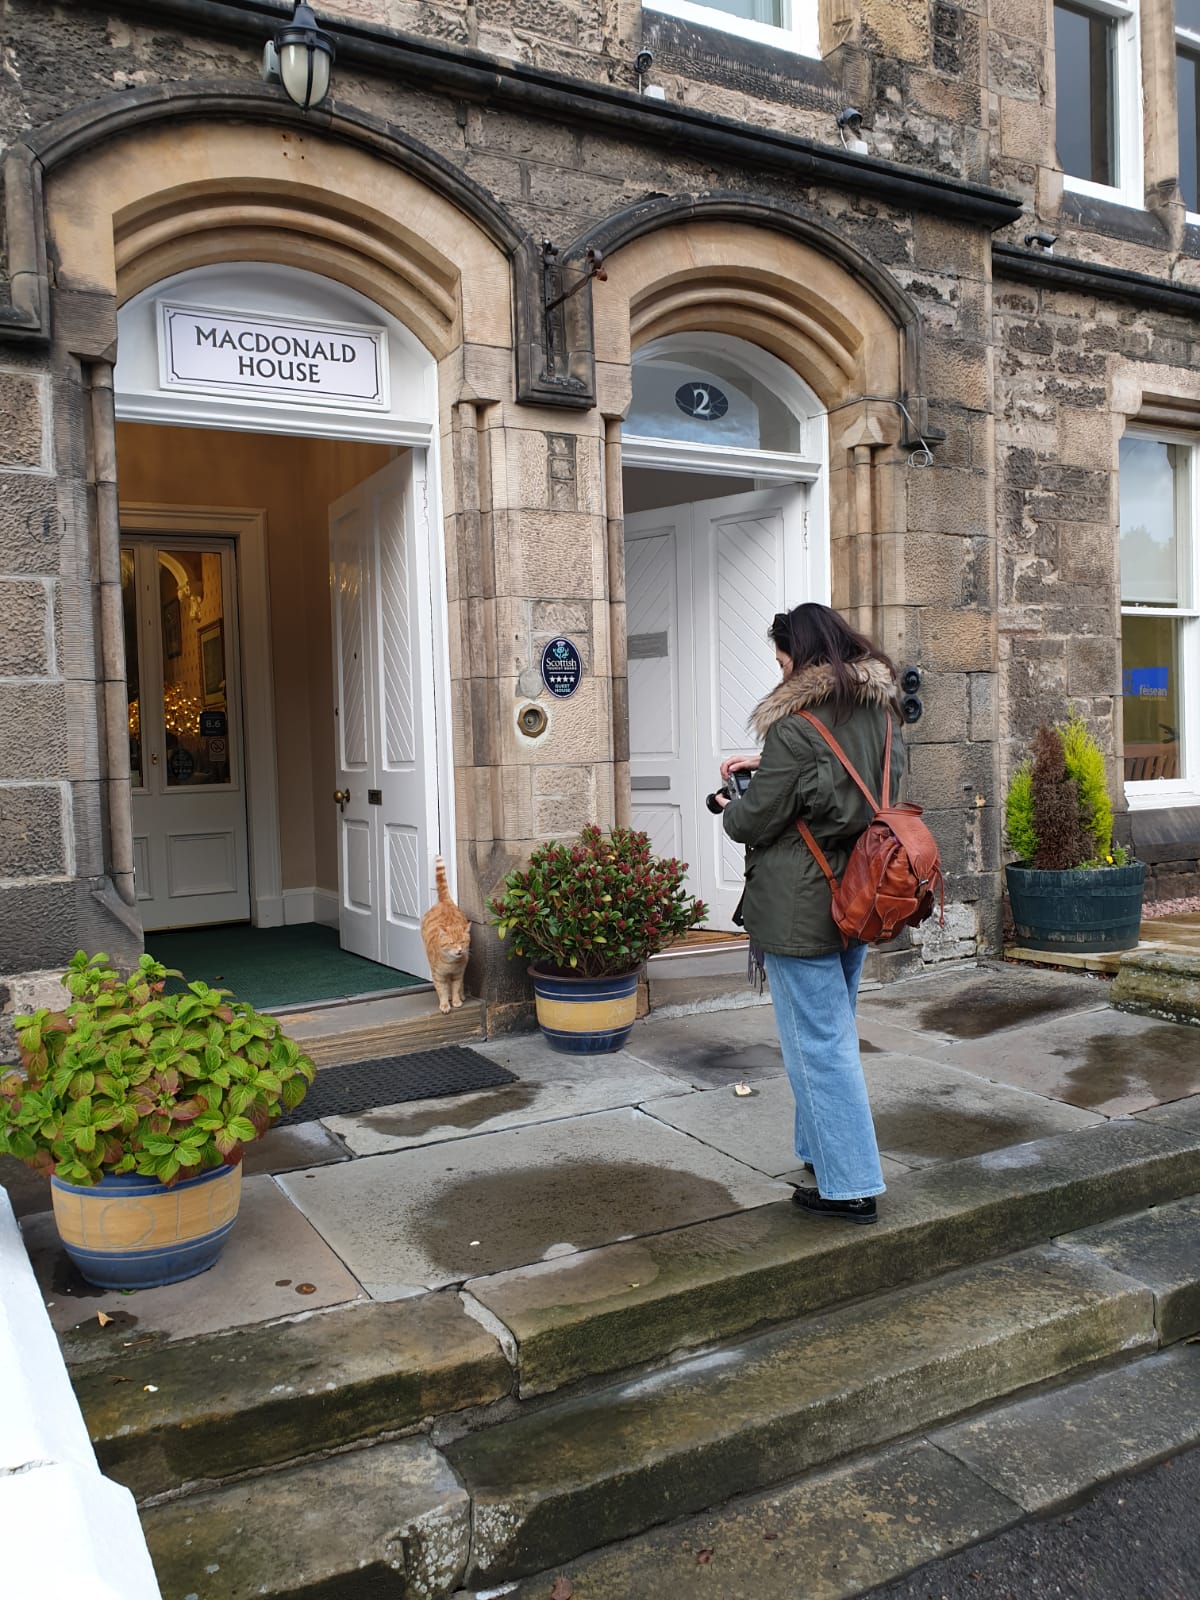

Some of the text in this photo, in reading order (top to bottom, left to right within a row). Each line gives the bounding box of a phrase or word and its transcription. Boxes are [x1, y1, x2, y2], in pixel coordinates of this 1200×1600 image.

[194, 325, 356, 363] MACDONALD
[238, 355, 321, 383] HOUSE
[693, 389, 711, 414] 2
[546, 657, 577, 667] Scottish
